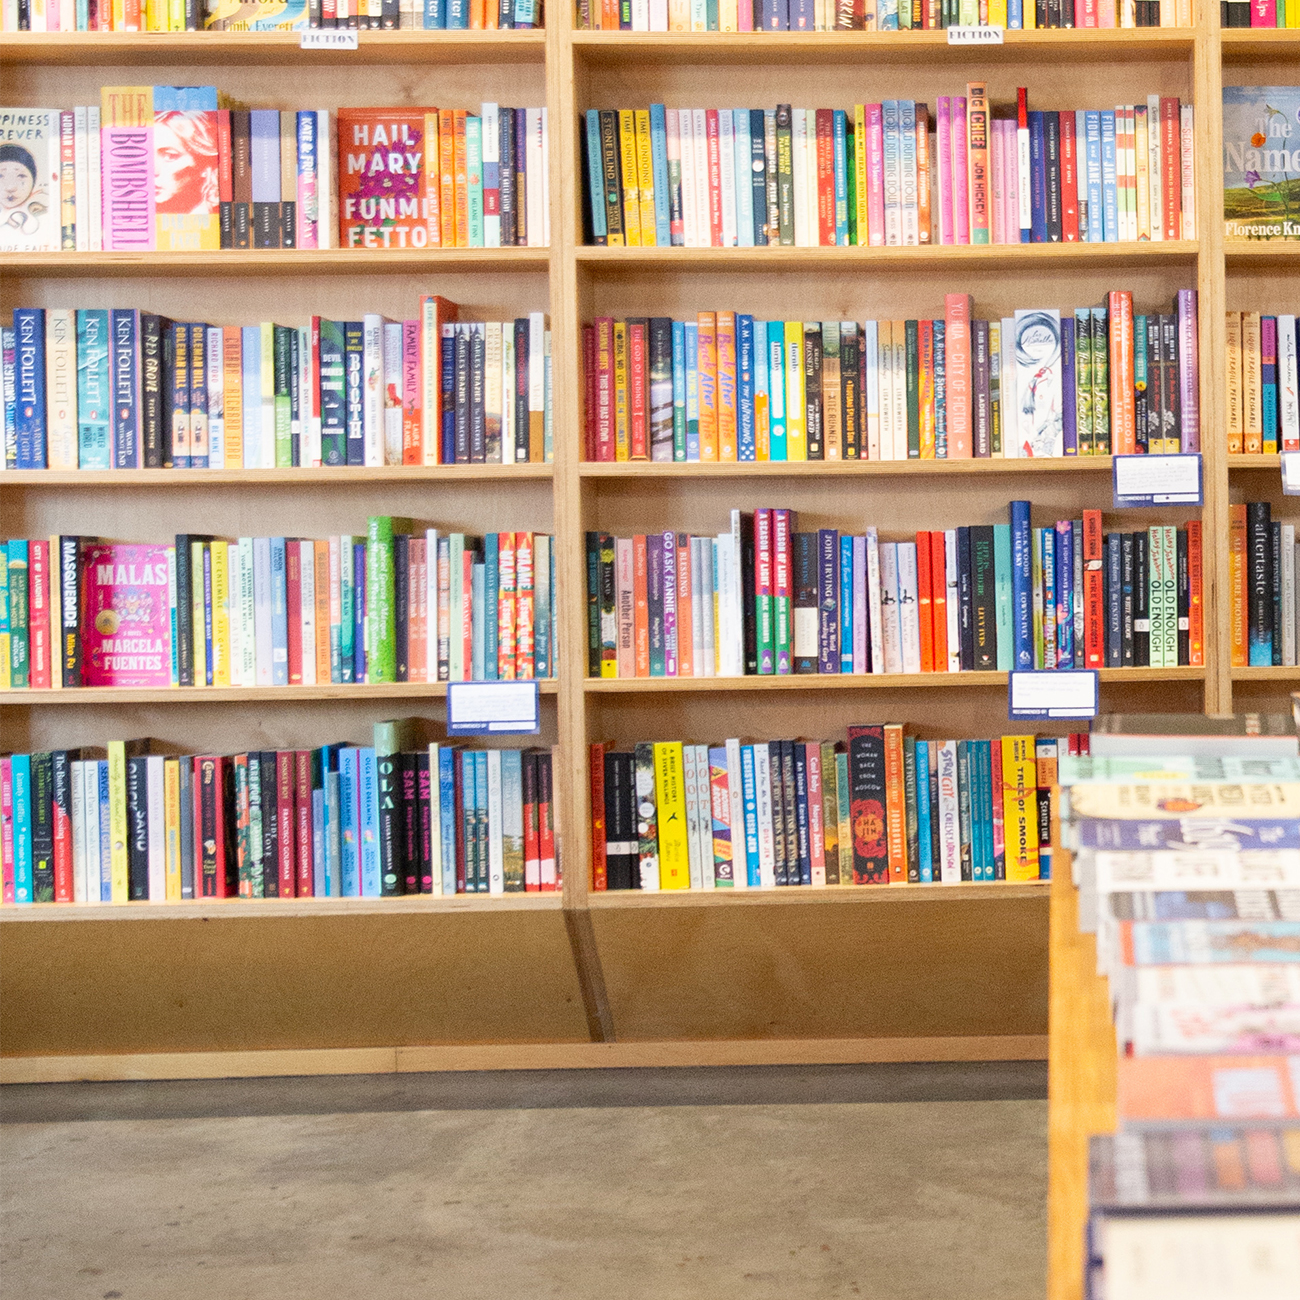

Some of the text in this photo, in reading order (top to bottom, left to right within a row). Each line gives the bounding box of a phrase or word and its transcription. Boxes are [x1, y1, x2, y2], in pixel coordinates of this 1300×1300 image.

[302, 34, 355, 44] FICTION
[949, 31, 1000, 39] FICTION
[108, 93, 150, 127] THE
[354, 124, 415, 146] HAIL
[1255, 117, 1293, 138] The
[348, 153, 423, 175] MARY
[972, 88, 985, 215] BIG CHIEF JON HICKEY
[110, 132, 149, 250] BOMBSHELL
[345, 199, 428, 220] FUNMI
[349, 226, 427, 249] FETTO
[1226, 222, 1281, 236] Florence
[118, 318, 132, 406] KEN FOLLETT
[952, 304, 966, 433] YU HUA CITY OF FICTION
[97, 564, 167, 585] MALAS
[664, 533, 674, 613] GO ASK FANNIE
[904, 524, 920, 594] aftertaste
[63, 543, 76, 668] MASQUERADE Mike Fu
[1165, 580, 1175, 651] OLD ENOUGH
[102, 639, 163, 653] MARCELA
[104, 656, 162, 671] FUENTES
[420, 770, 430, 799] SAM
[809, 757, 821, 857] Caul Baby Morgan Jerkins
[1018, 767, 1027, 862] TREE OF SMOKE
[892, 810, 901, 858] JODOROWSKY
